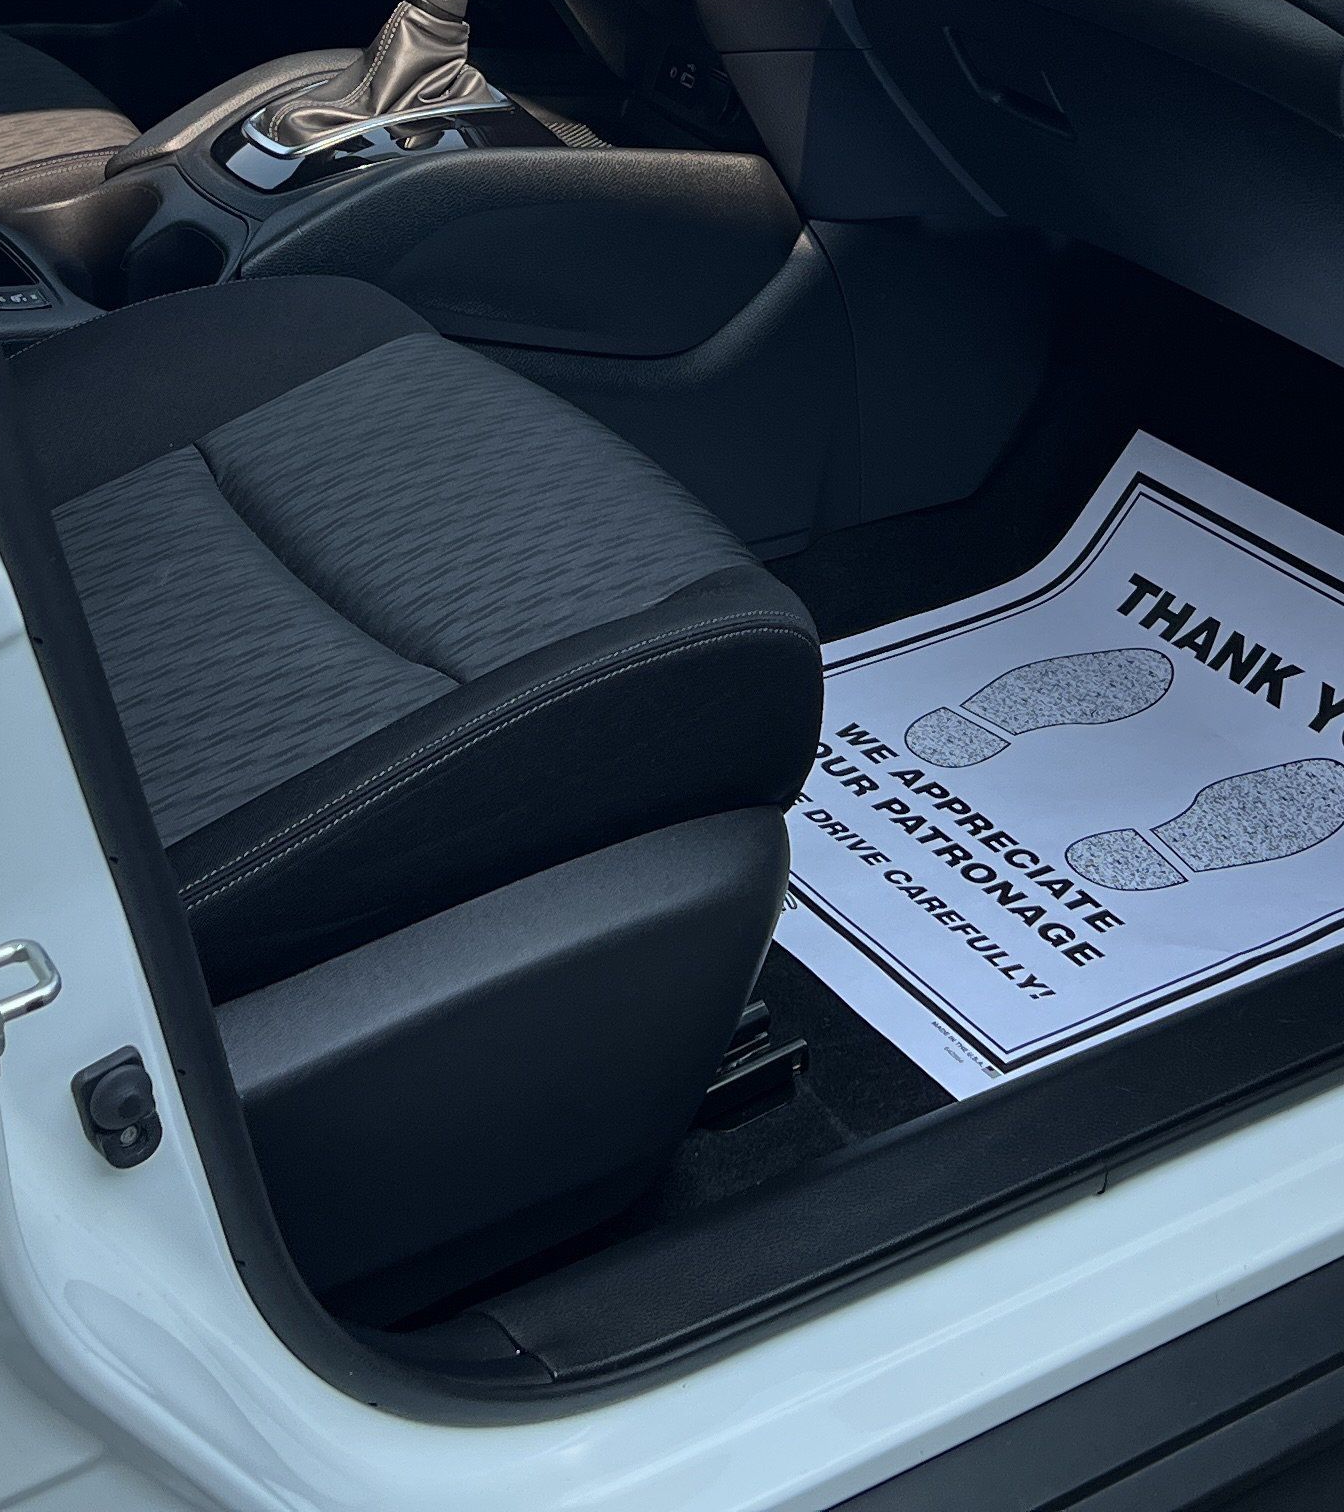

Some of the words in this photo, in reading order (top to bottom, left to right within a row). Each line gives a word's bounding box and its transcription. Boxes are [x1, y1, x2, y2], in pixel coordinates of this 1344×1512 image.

[1116, 572, 1306, 709] THANK
[803, 808, 892, 866] DRIVE
[883, 869, 1057, 1000] CAREFULLY!
[814, 741, 880, 797] OUR
[871, 797, 1106, 968] PATRONAGE
[835, 721, 900, 765] WE
[888, 768, 1126, 934] APPRECIATE
